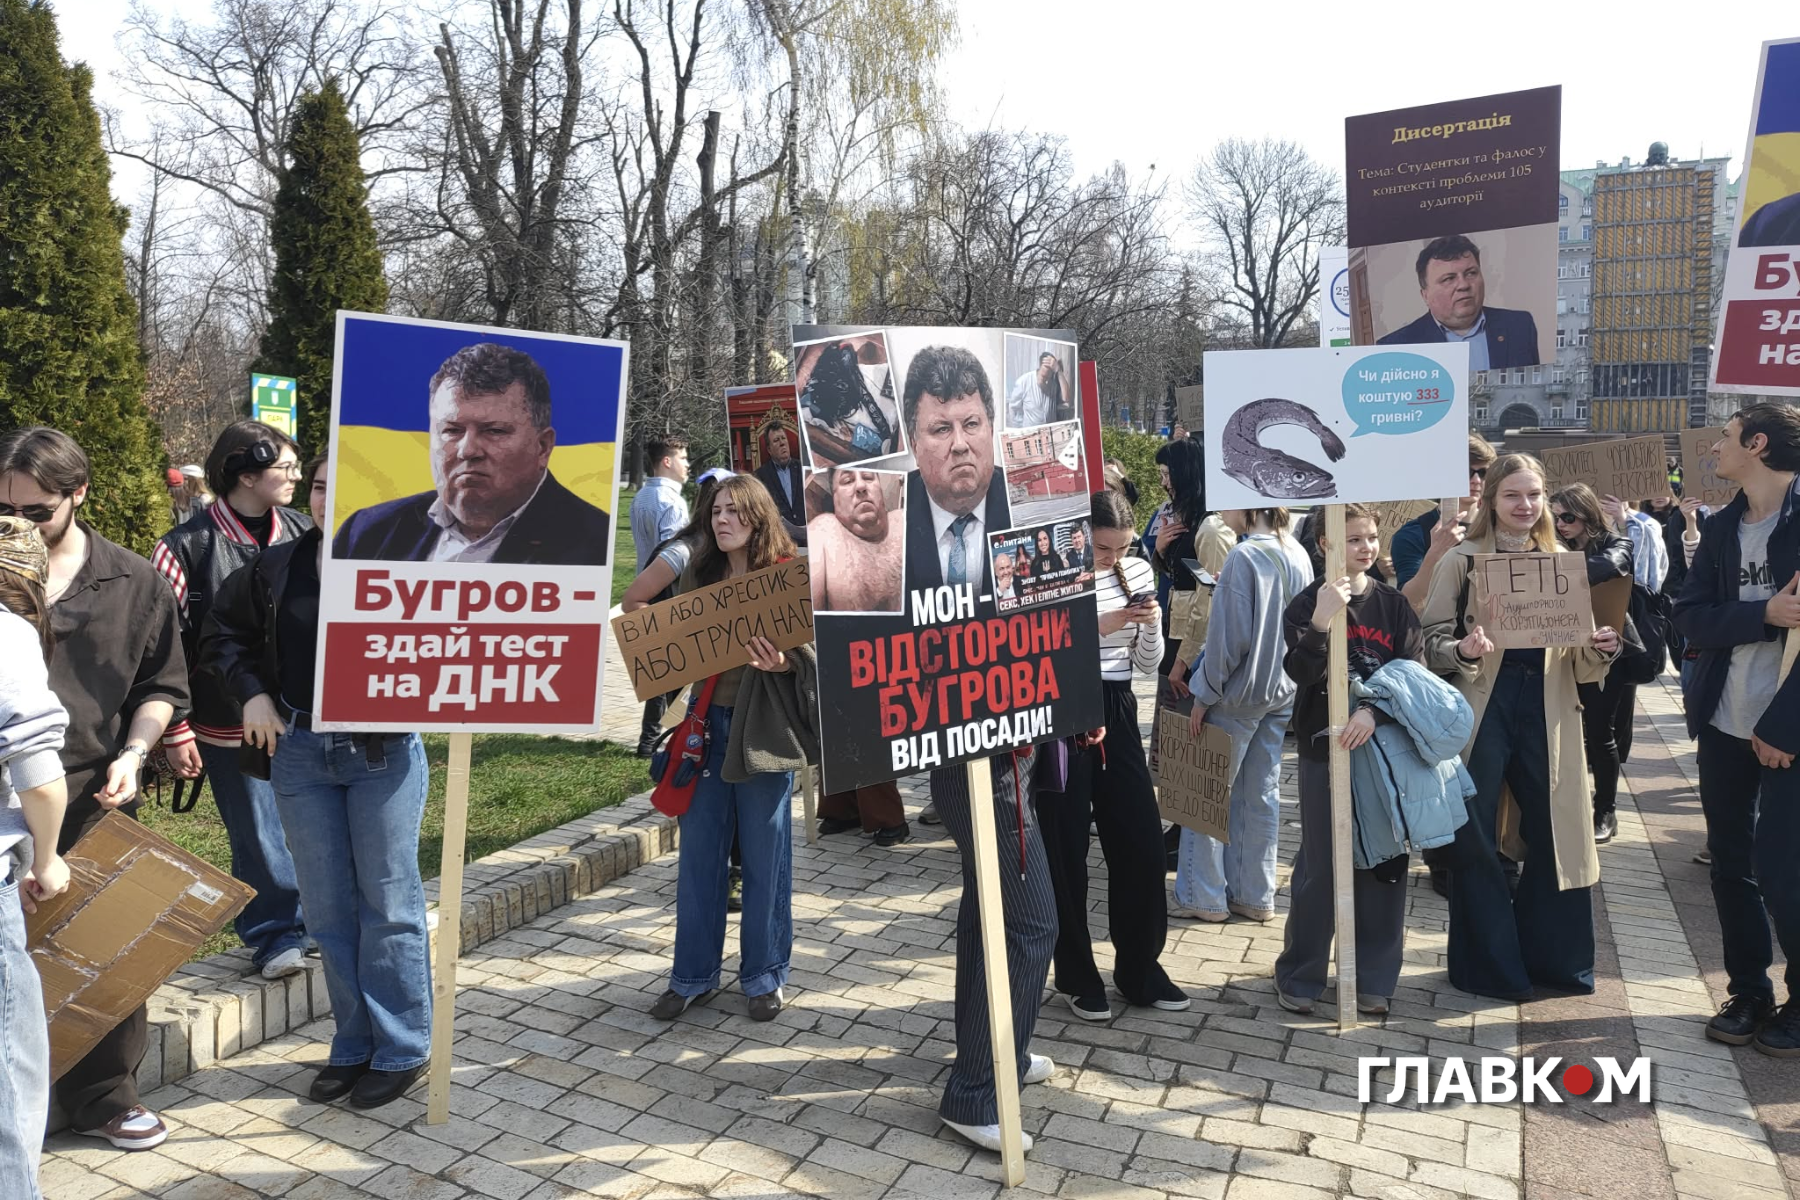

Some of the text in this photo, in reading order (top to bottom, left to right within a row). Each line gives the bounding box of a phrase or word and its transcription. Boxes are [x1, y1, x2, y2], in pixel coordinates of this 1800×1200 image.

[1392, 113, 1512, 145] Дисертація
[1358, 145, 1546, 180] Тема: Студентки та фалос у
[1372, 164, 1532, 197] контексті проблеми 105
[1419, 190, 1484, 211] аудиторії
[1358, 368, 1439, 384] Чи дійсно я
[1358, 388, 1439, 405] коштую 333
[1371, 410, 1423, 426] гривні?
[1485, 556, 1569, 595] ГЕТЬ
[355, 569, 560, 621] Бугров
[621, 612, 659, 643] ВИ
[670, 596, 704, 625] АБО
[709, 568, 794, 612] ХРЕСТИК
[911, 582, 975, 626] МОН
[999, 598, 1020, 611] СЕКС,
[364, 626, 569, 663] здай тест
[634, 642, 686, 688] АБО
[686, 612, 765, 663] ТРУСИ
[849, 607, 1072, 688] ВІДСТОРОНИ
[367, 664, 562, 712] на ДНК
[879, 656, 1060, 738] БУГРОВА
[891, 705, 1053, 772] ВІД ПОСАДИ!
[1160, 762, 1228, 805] ДУХ ЩО ШЕВУ
[1160, 786, 1180, 810] РВЕ
[1181, 794, 1199, 818] ДО
